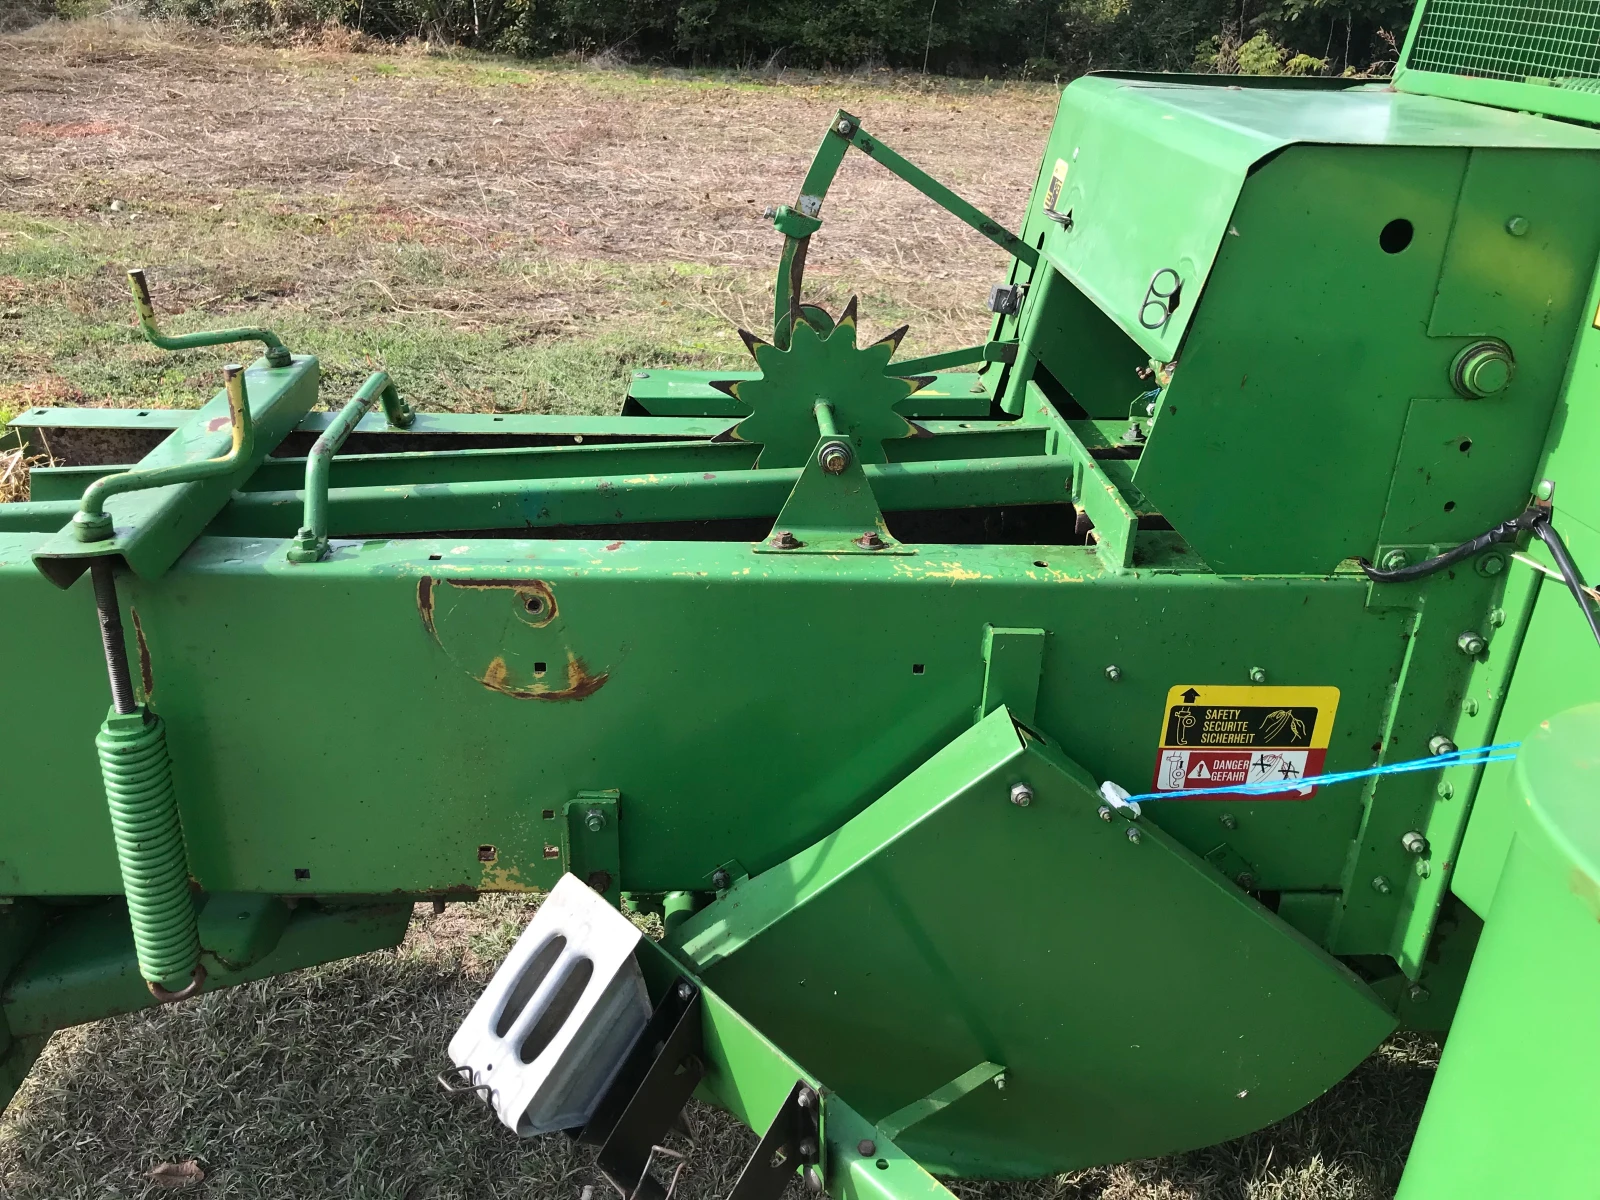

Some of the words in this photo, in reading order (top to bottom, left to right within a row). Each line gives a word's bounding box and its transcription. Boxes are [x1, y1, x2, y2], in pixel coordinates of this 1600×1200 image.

[1205, 709, 1241, 720] SAFETY
[1203, 721, 1249, 732] SECURITE
[1201, 733, 1255, 744] SICHERHEIT
[1213, 760, 1250, 770] DANGER
[1211, 771, 1245, 782] GEFAHR
